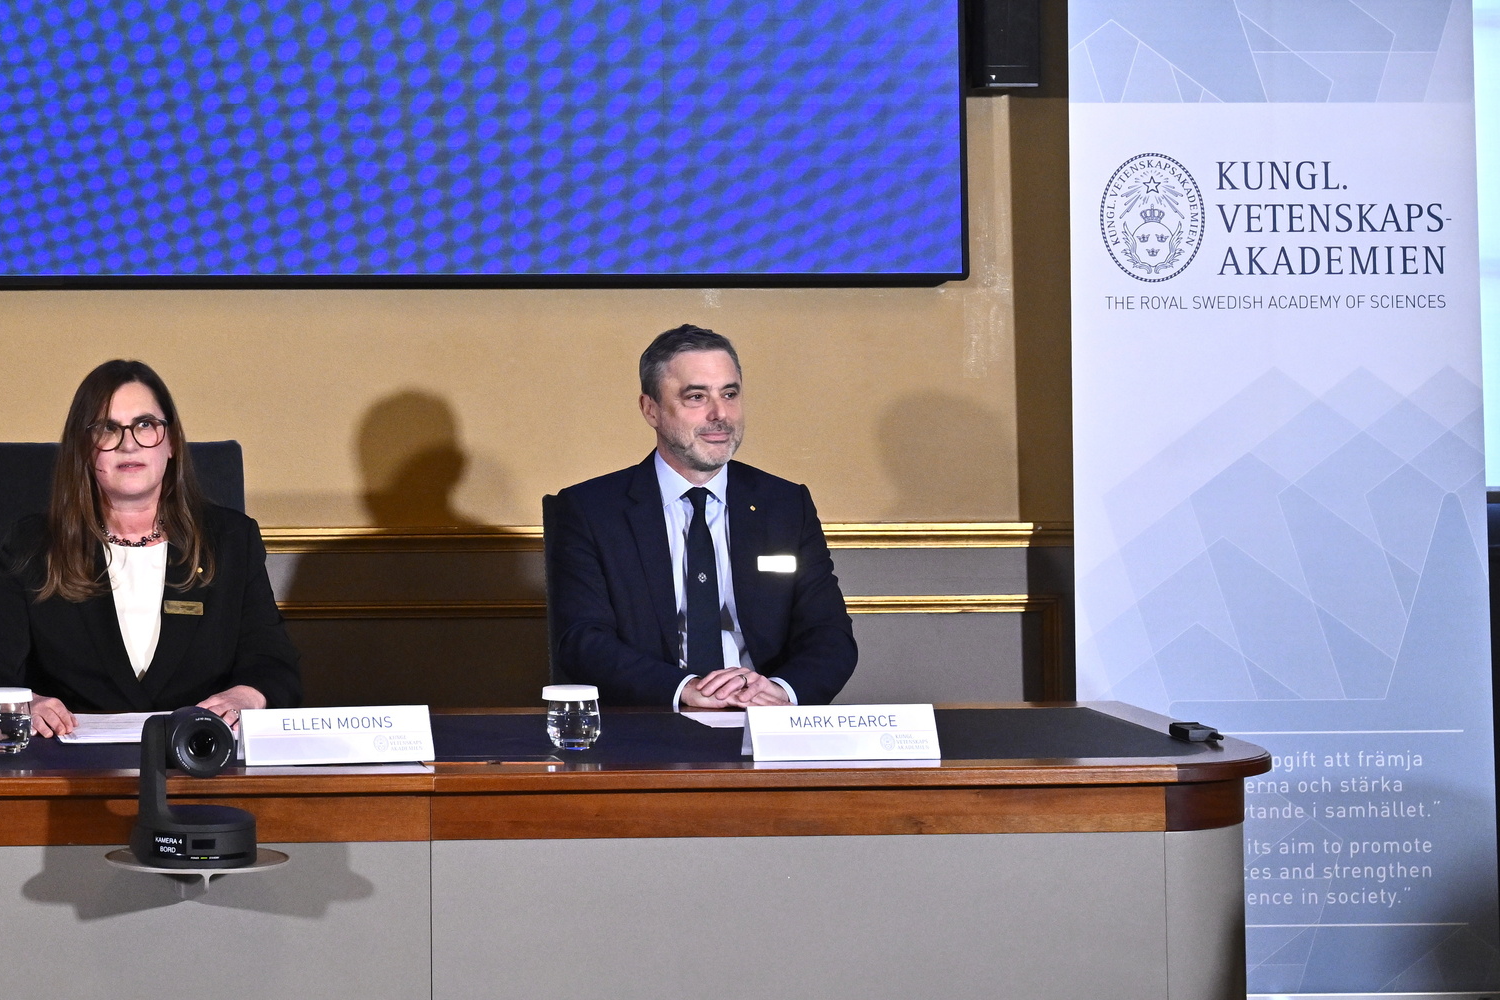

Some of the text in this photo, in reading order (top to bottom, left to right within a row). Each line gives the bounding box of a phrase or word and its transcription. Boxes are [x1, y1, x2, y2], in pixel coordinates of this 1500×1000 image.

[1216, 161, 1347, 190] KUNGL.
[1107, 159, 1198, 248] KUNGL. VETENSKAPSAKADEMIEN
[1216, 203, 1452, 233] VETENSKAPS-
[1217, 246, 1446, 275] AKADEMIEN
[1105, 295, 1446, 310] THE ROYAL SWEDISH ACADEMY OF SCIENCES
[283, 716, 392, 731] ELLEN MOONS
[790, 715, 897, 728] MARK PEARCE
[1272, 751, 1422, 772] pgift att främja
[1298, 778, 1331, 794] och
[1340, 778, 1402, 792] stärka
[1313, 802, 1316, 818] i
[1279, 839, 1314, 854] aim
[1324, 838, 1341, 853] to
[1350, 839, 1432, 858] promote
[1279, 864, 1314, 879] and
[1323, 863, 1432, 883] strengthen
[1302, 889, 1318, 904] in
